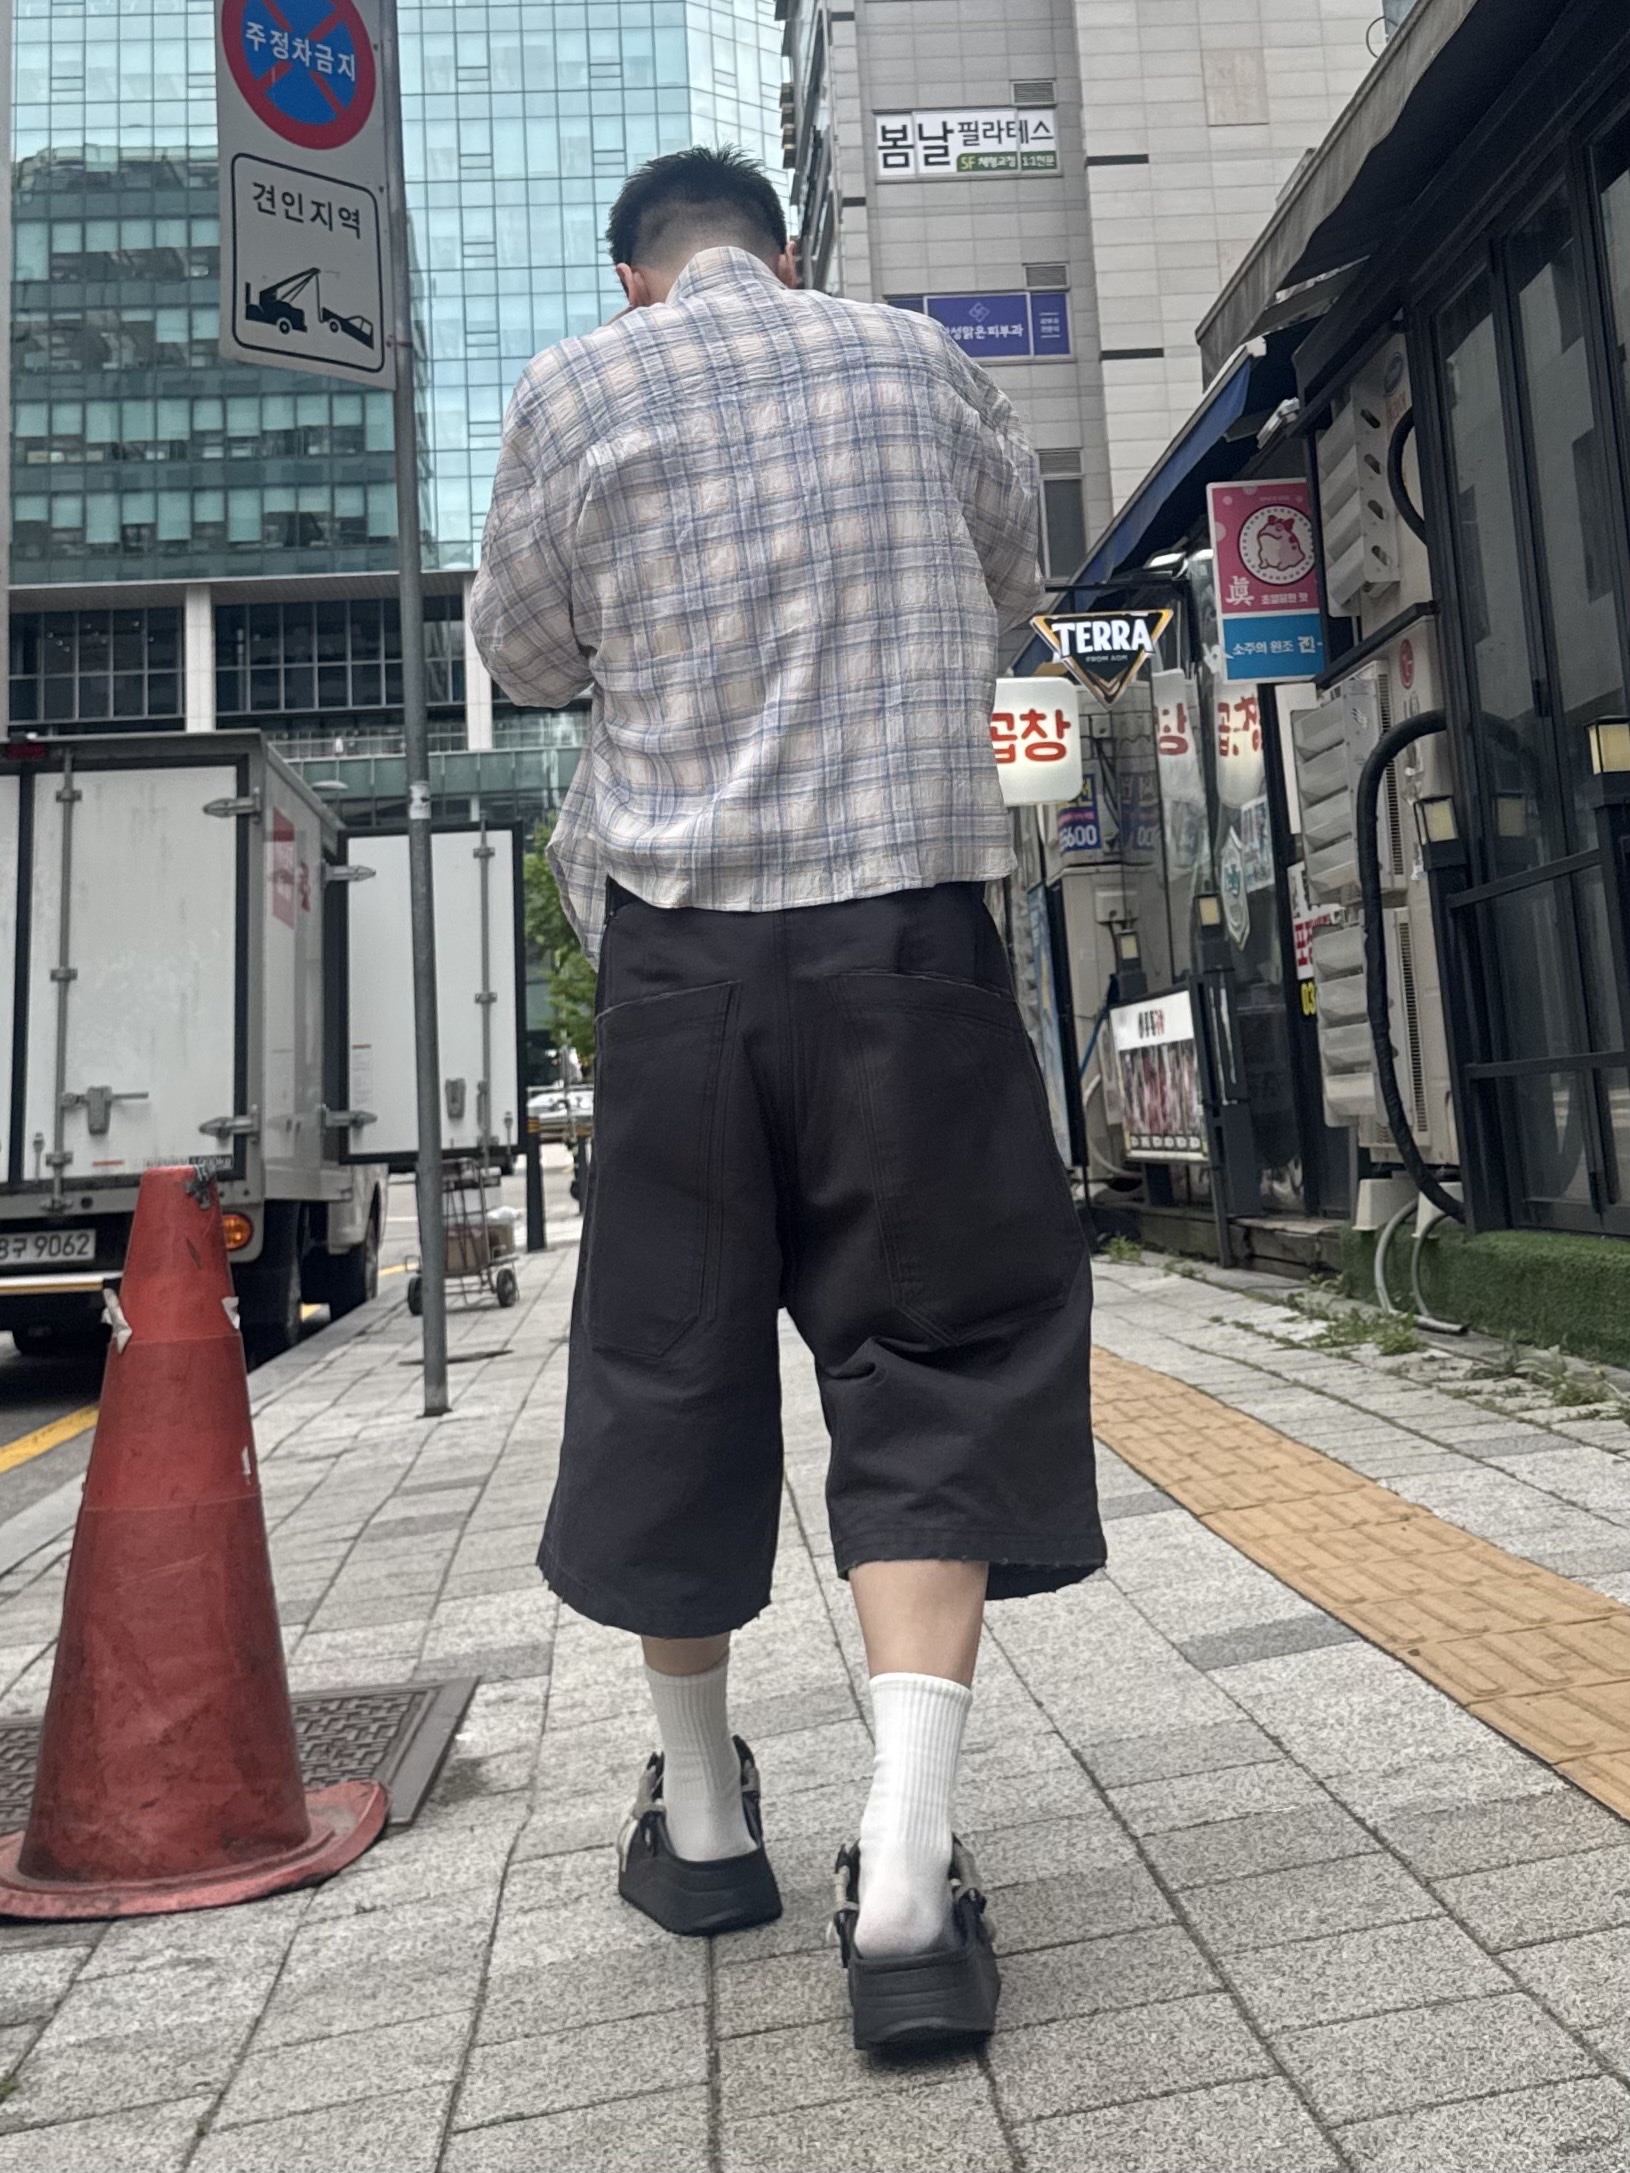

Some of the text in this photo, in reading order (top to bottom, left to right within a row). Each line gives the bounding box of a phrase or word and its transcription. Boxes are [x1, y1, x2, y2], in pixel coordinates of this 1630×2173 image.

[246, 22, 356, 82] 주정차금지
[878, 120, 1054, 168] 봄날 필라테스
[960, 156, 975, 170] SF
[252, 182, 361, 239] 견인지역
[1051, 618, 1153, 657] TERRA
[1232, 641, 1267, 655] 소주의
[1270, 640, 1294, 653] 원조
[989, 708, 1071, 764] 곱창
[35, 1233, 90, 1257] 9062
